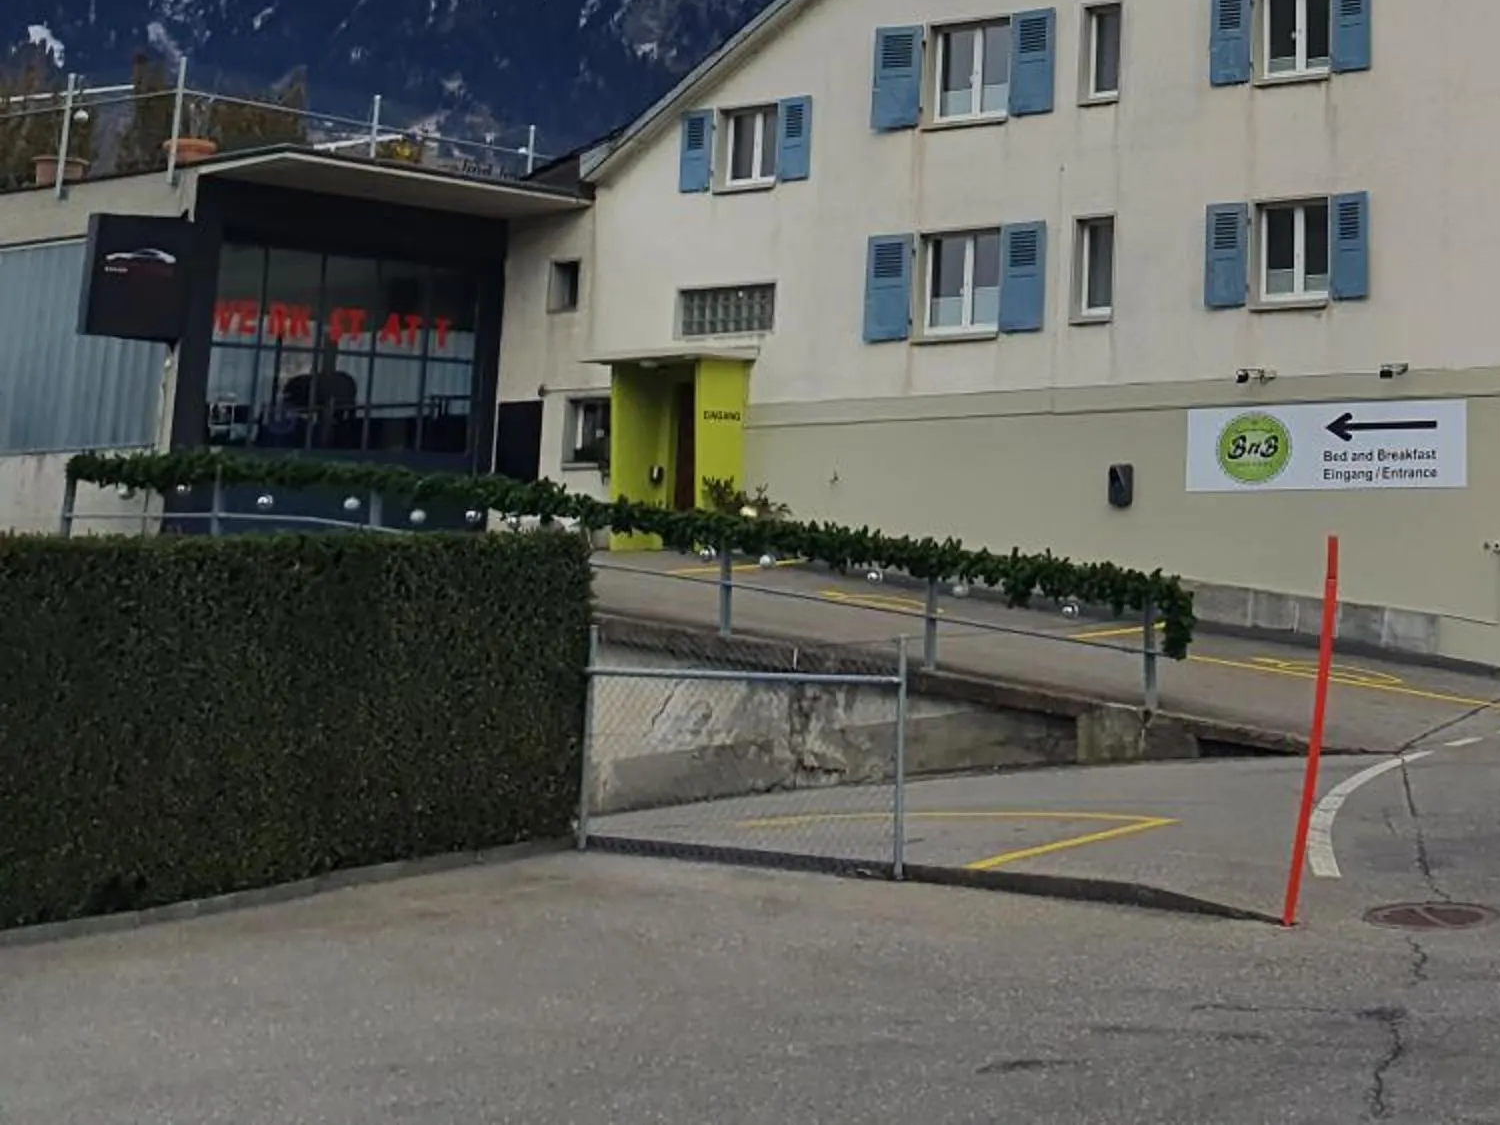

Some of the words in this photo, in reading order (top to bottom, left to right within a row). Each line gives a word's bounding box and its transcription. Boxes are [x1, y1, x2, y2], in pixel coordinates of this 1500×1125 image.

[1323, 450, 1348, 462] Bed
[1351, 451, 1373, 462] and
[1377, 448, 1437, 462] Breakfast
[1323, 468, 1373, 483] Eingang
[1382, 466, 1437, 479] Entrance
